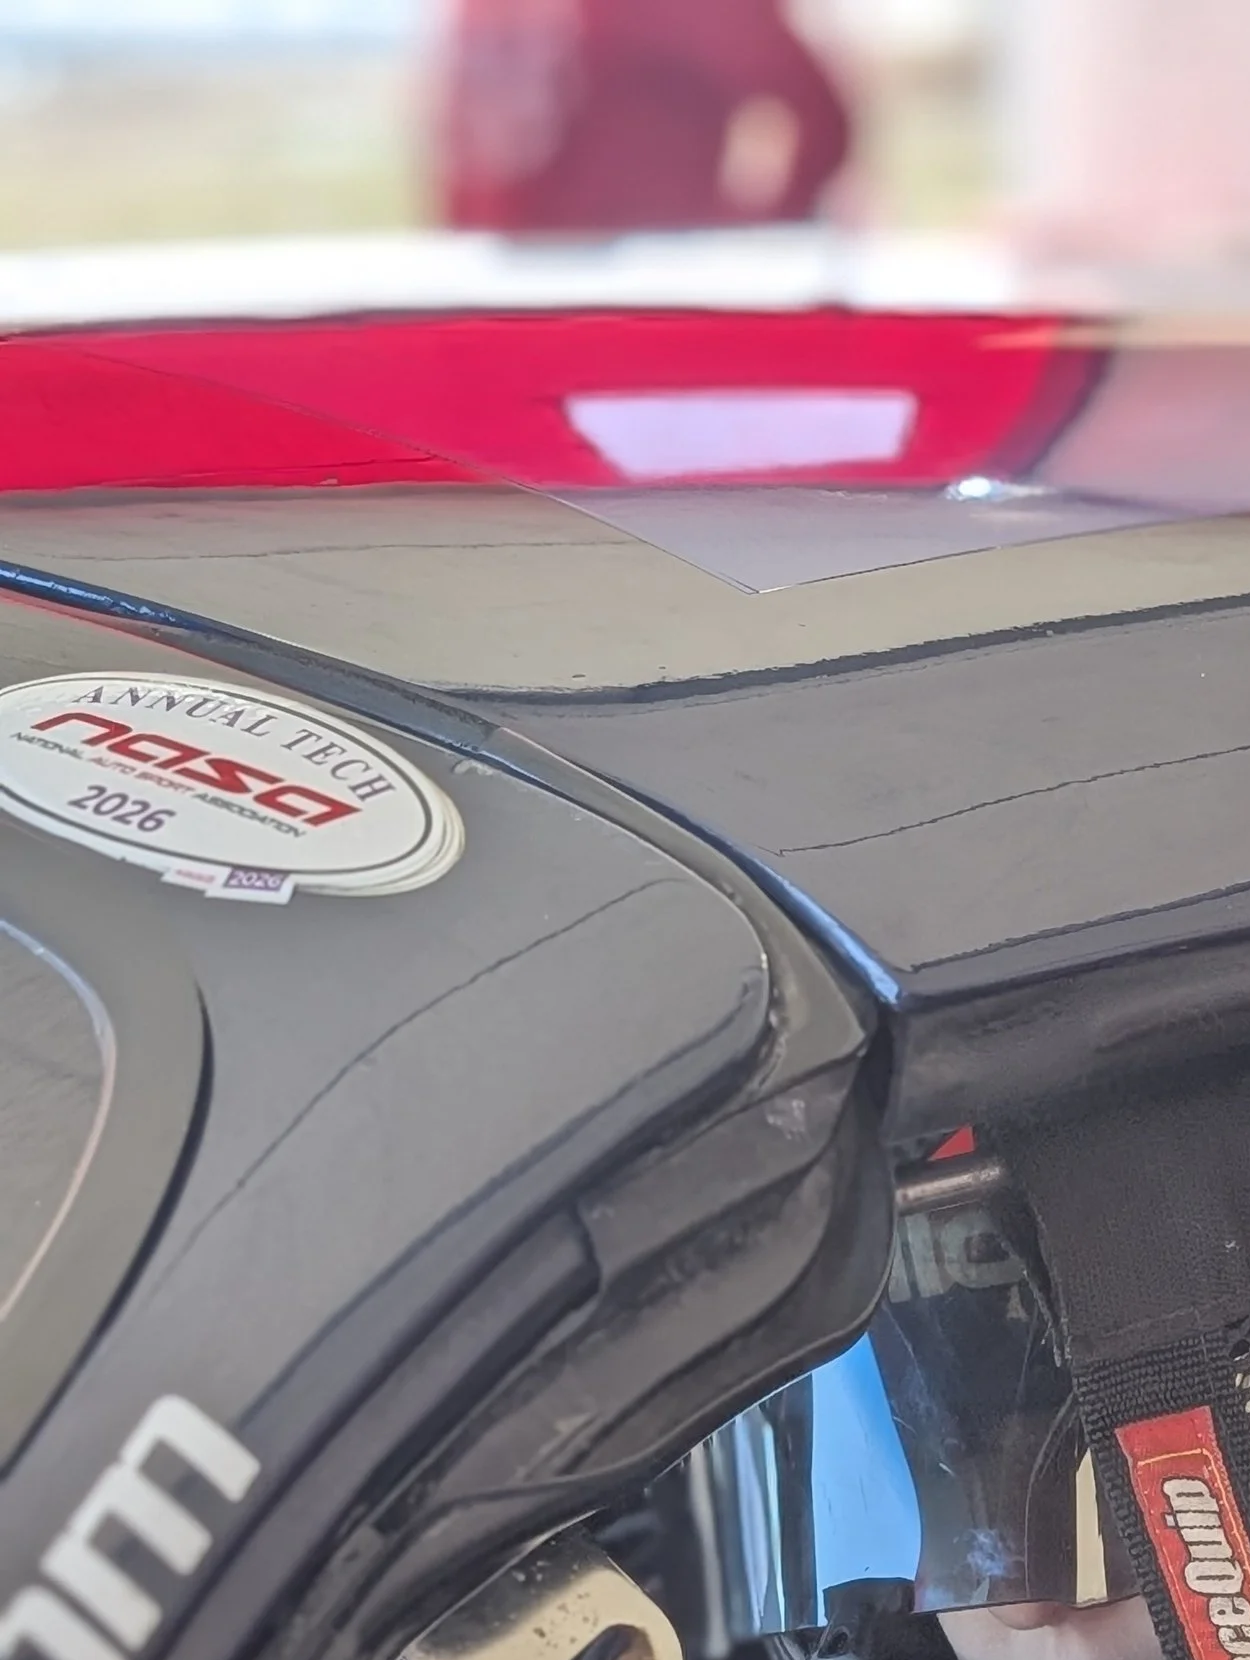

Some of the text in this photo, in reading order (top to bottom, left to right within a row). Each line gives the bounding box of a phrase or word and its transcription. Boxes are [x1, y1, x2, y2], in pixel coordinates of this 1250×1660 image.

[71, 685, 398, 802] ANNUAL TECH
[10, 732, 306, 838] NATIONAL AUTO SPORT ASSOCIATION
[68, 784, 178, 833] 2026
[228, 869, 283, 889] 2026
